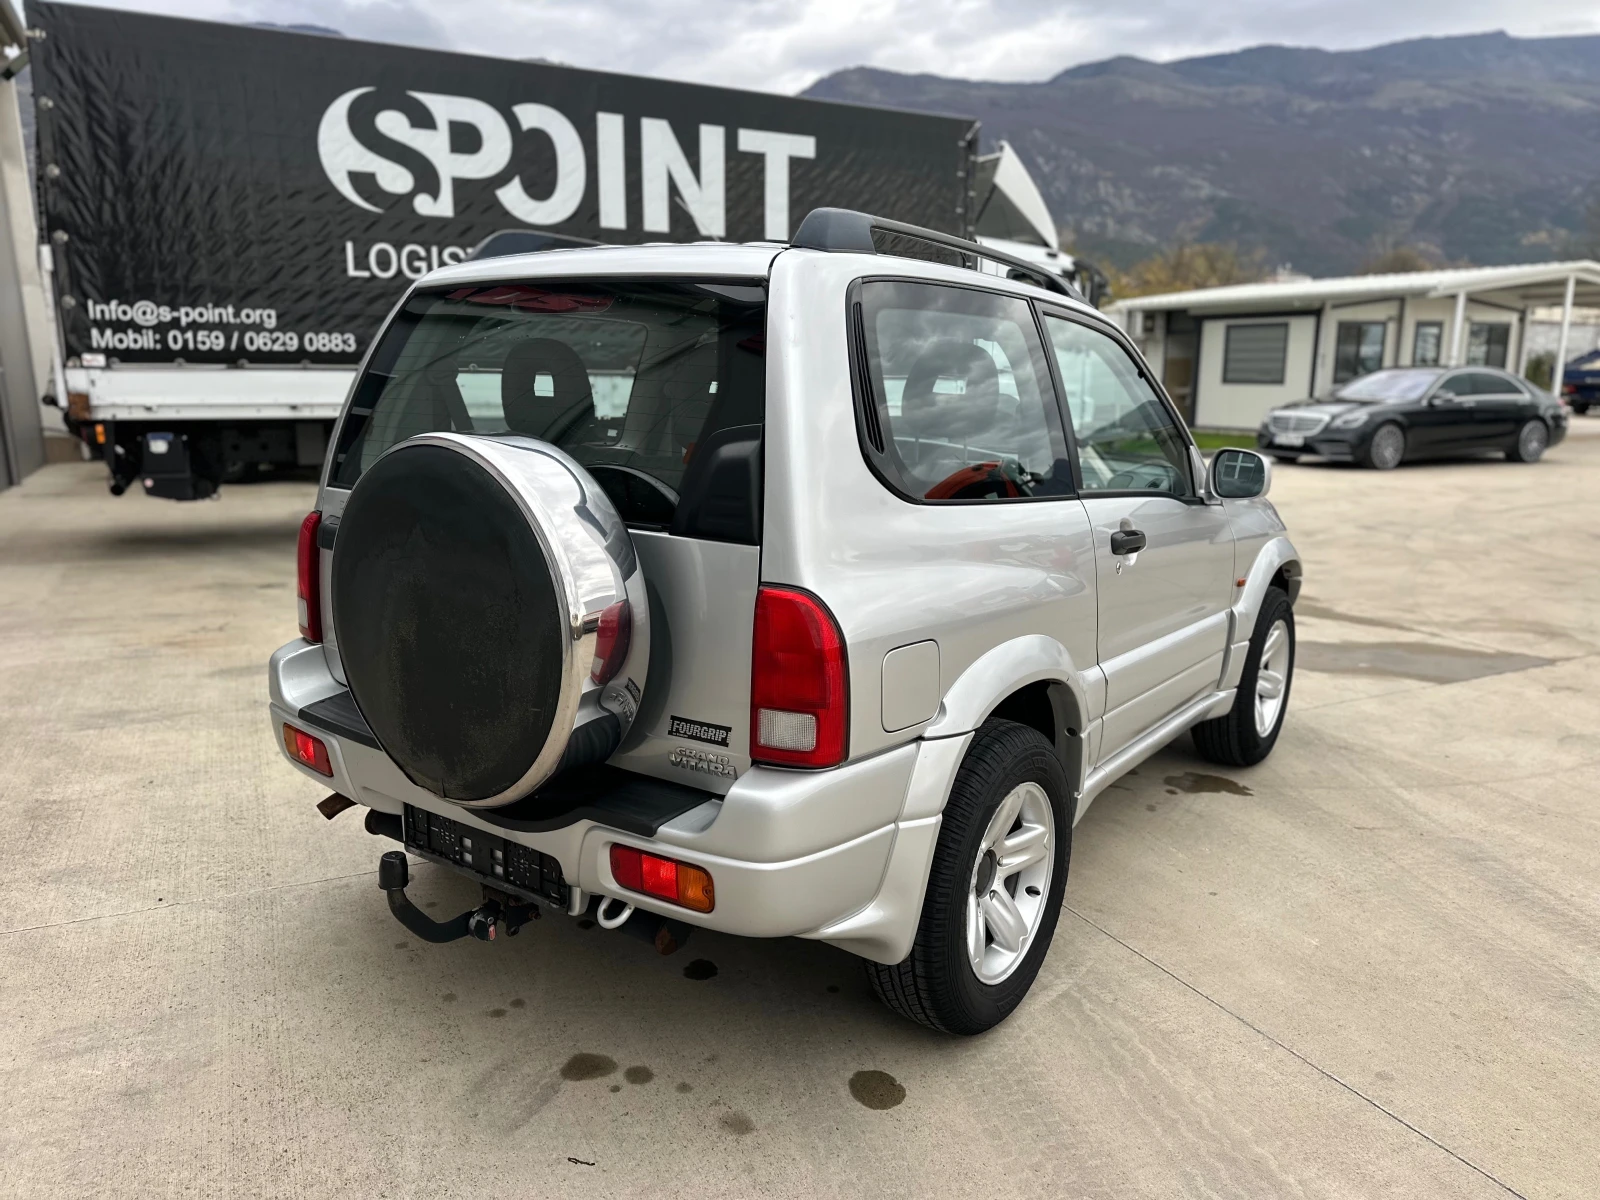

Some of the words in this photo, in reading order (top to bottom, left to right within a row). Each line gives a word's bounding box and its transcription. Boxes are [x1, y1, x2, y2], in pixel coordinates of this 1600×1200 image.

[345, 240, 474, 281] LOGIS
[87, 299, 277, 329] Info@s-point.org
[90, 328, 162, 350] Mobil:
[167, 330, 225, 351] 0159
[230, 331, 239, 350] /
[244, 331, 298, 352] 0629
[303, 333, 357, 353] 0883
[672, 720, 727, 742] FOURGRIP
[667, 750, 738, 781] VITARA
[675, 746, 730, 765] GRAND
